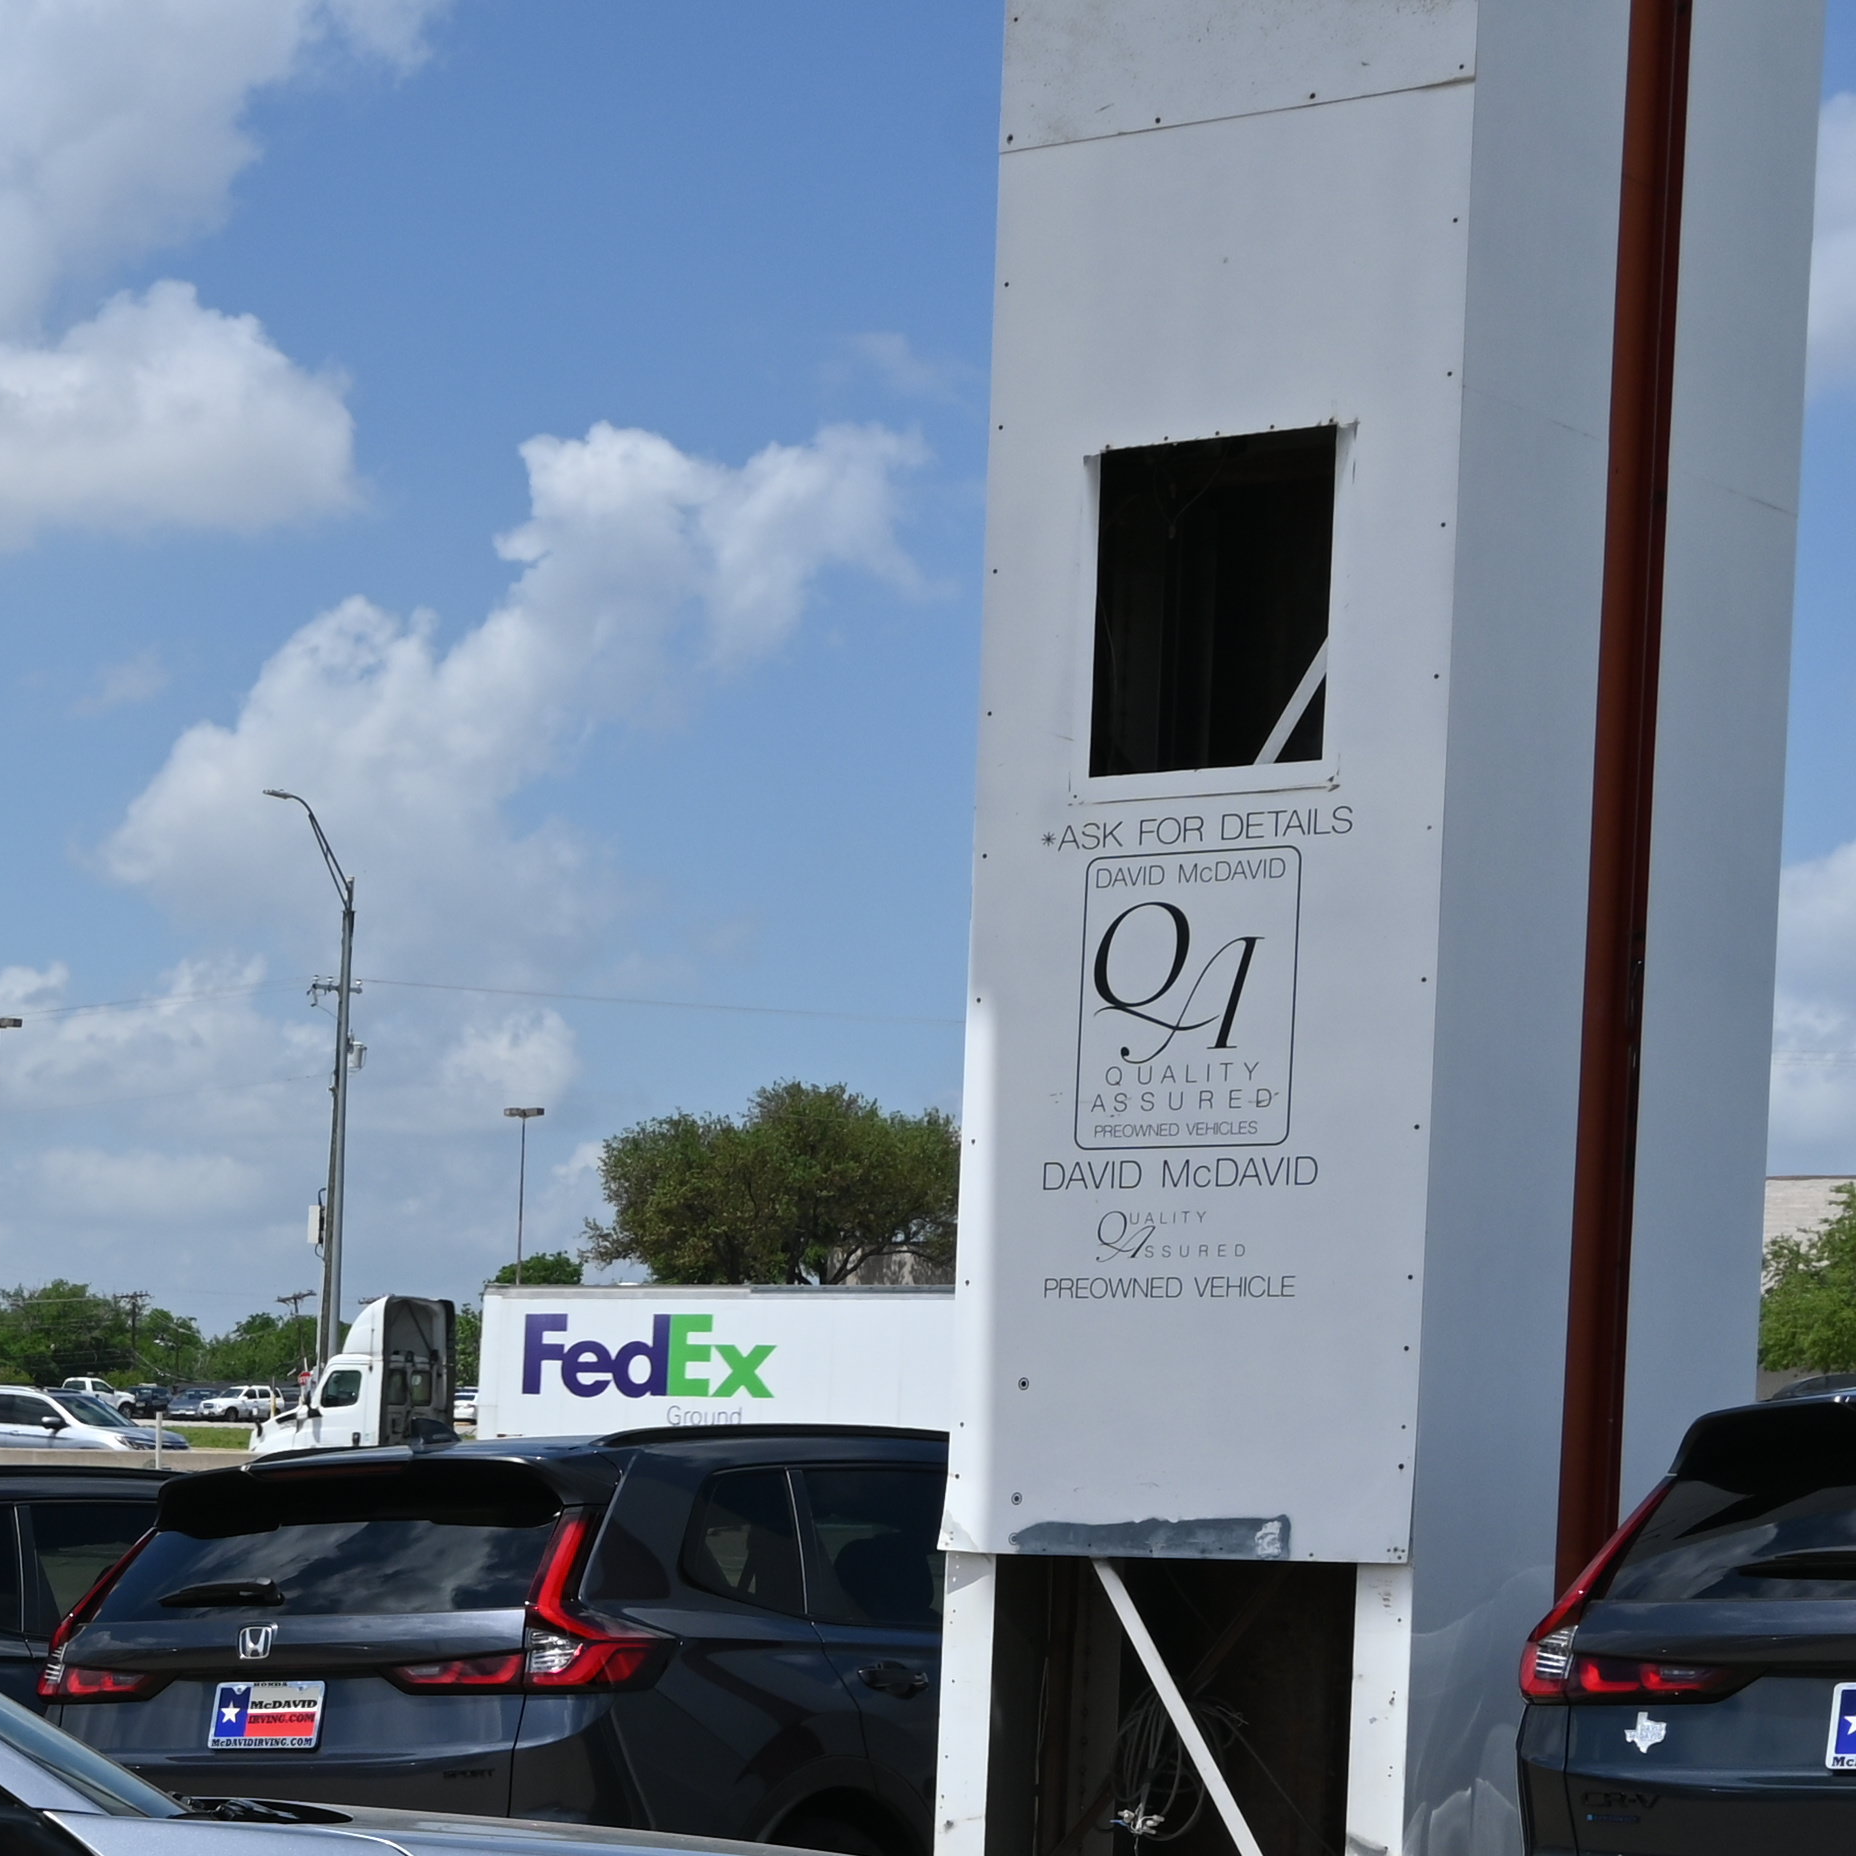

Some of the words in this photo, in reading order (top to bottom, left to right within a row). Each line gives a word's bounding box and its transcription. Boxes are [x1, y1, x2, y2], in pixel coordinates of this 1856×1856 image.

[1138, 816, 1205, 847] FOR
[1220, 806, 1354, 841] DETAILS
[1095, 864, 1166, 889] DAVID
[1177, 857, 1286, 884] McDAVID
[1104, 1061, 1260, 1087] QUALITY
[1090, 1087, 1273, 1113] ASSURED
[1093, 1122, 1180, 1138] PREOWNED
[1186, 1120, 1258, 1136] VEHICLES
[1042, 1160, 1143, 1190] DAVID
[1161, 1156, 1319, 1188] McDAVID
[1043, 1276, 1183, 1300] PREOWNED
[1194, 1275, 1297, 1299] VEHICLE
[521, 1313, 778, 1398] FedEx
[666, 1405, 744, 1428] Ground
[249, 1699, 319, 1710] McDAVID
[247, 1713, 316, 1724] IRVING.COM
[210, 1737, 314, 1748] McDAVIDIRVING.COM
